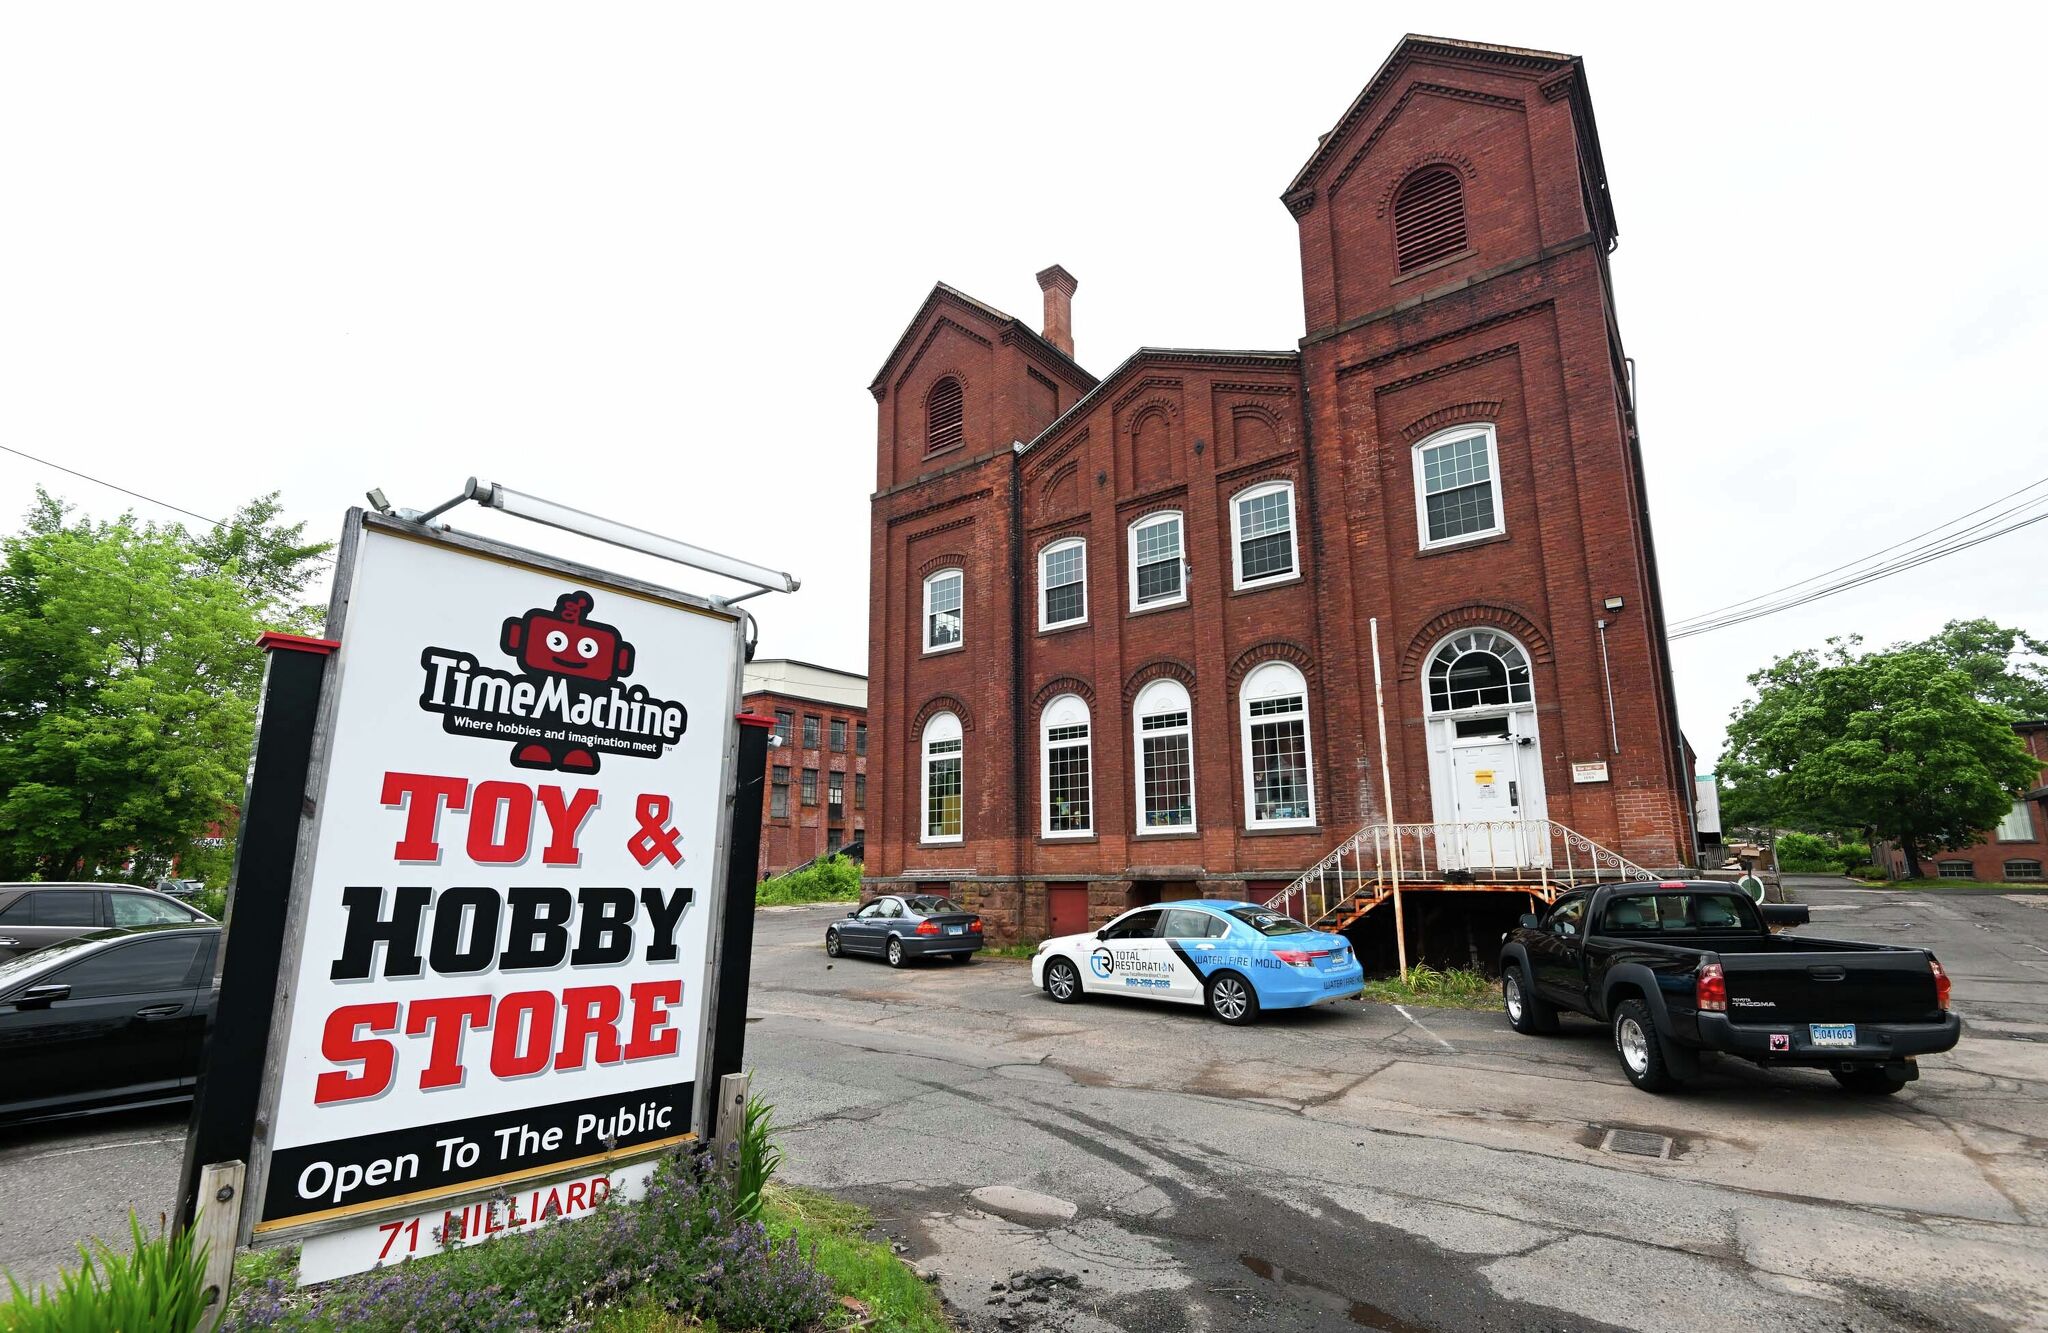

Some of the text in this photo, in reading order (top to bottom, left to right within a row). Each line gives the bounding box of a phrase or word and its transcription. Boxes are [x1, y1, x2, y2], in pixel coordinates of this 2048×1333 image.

[429, 655, 682, 738] TimeMachine
[454, 715, 657, 753] Where hobbies and imagination meet
[380, 771, 685, 869] TOY &
[329, 886, 694, 982] HOBBY
[1116, 951, 1140, 961] TOTAL
[1195, 955, 1282, 969] WATER FIRE MOLD
[314, 979, 684, 1106] STORE
[298, 1101, 673, 1204] Open To The Public
[377, 1177, 611, 1260] 71 HILLIARD
